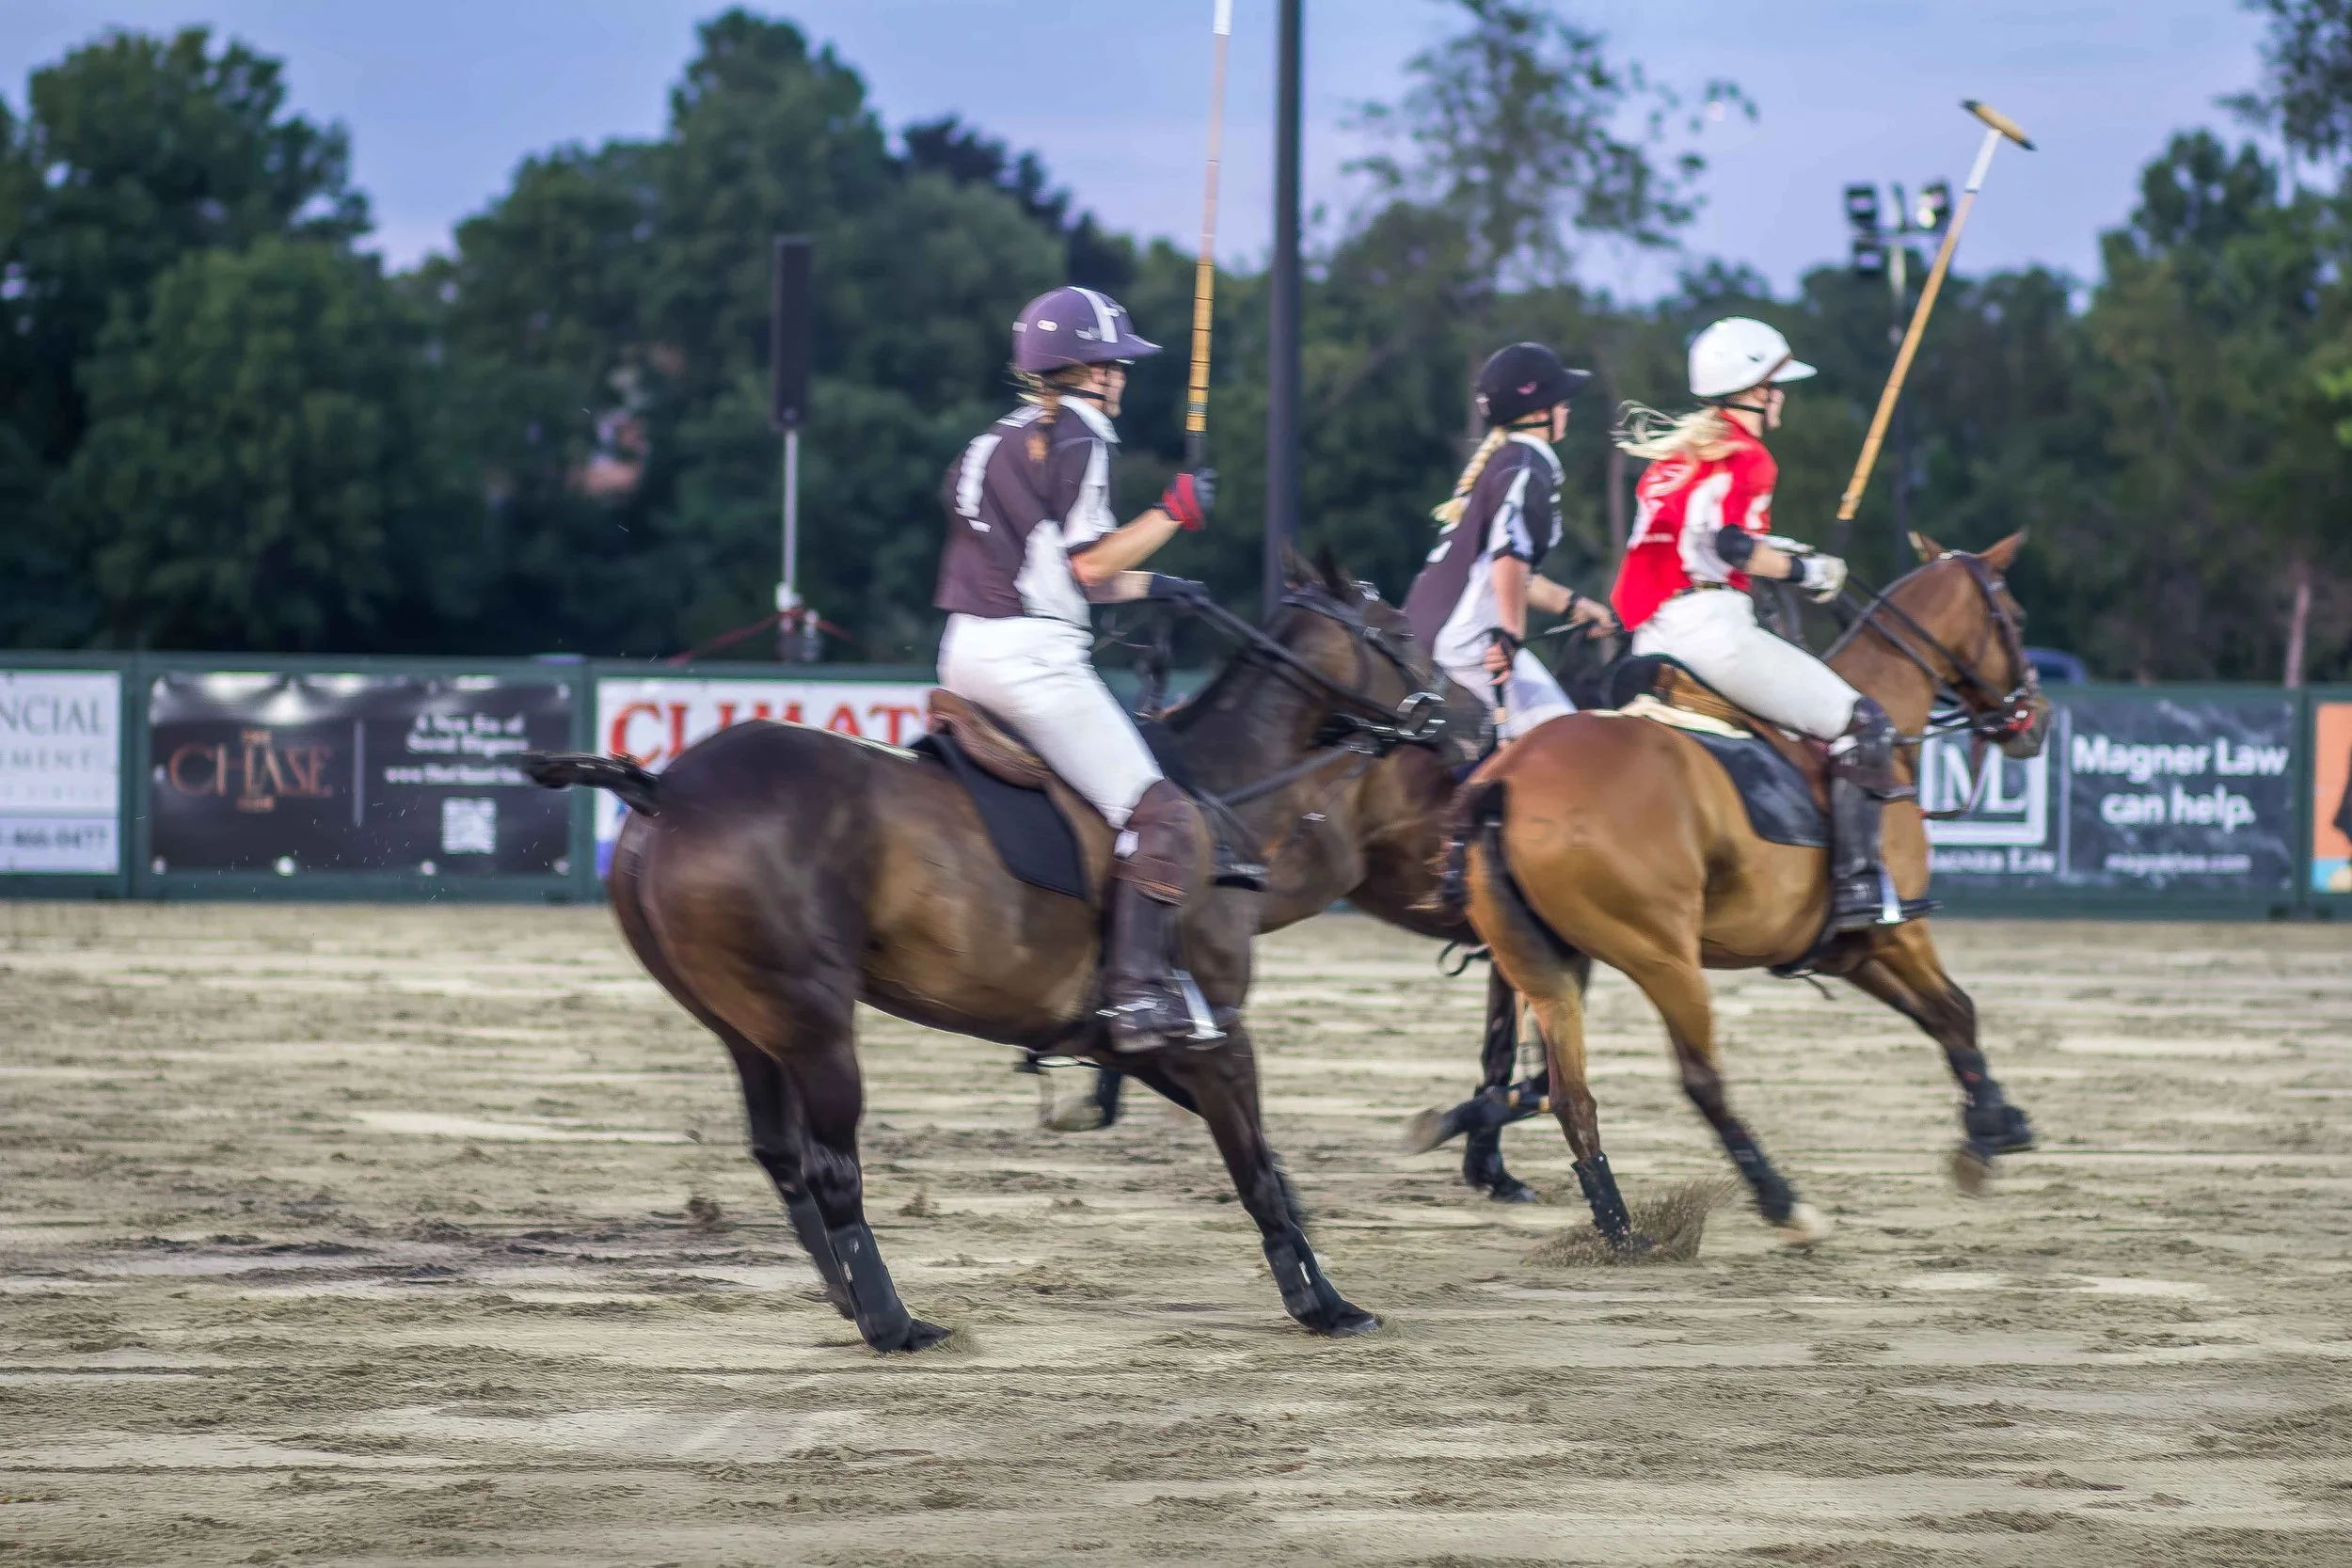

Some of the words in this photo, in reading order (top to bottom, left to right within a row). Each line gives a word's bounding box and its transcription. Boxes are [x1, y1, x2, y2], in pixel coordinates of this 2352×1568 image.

[168, 741, 334, 799] CHASE
[2073, 735, 2211, 784] Magner
[2216, 736, 2290, 776] Law
[2100, 793, 2167, 826] can
[2170, 783, 2258, 835] help.
